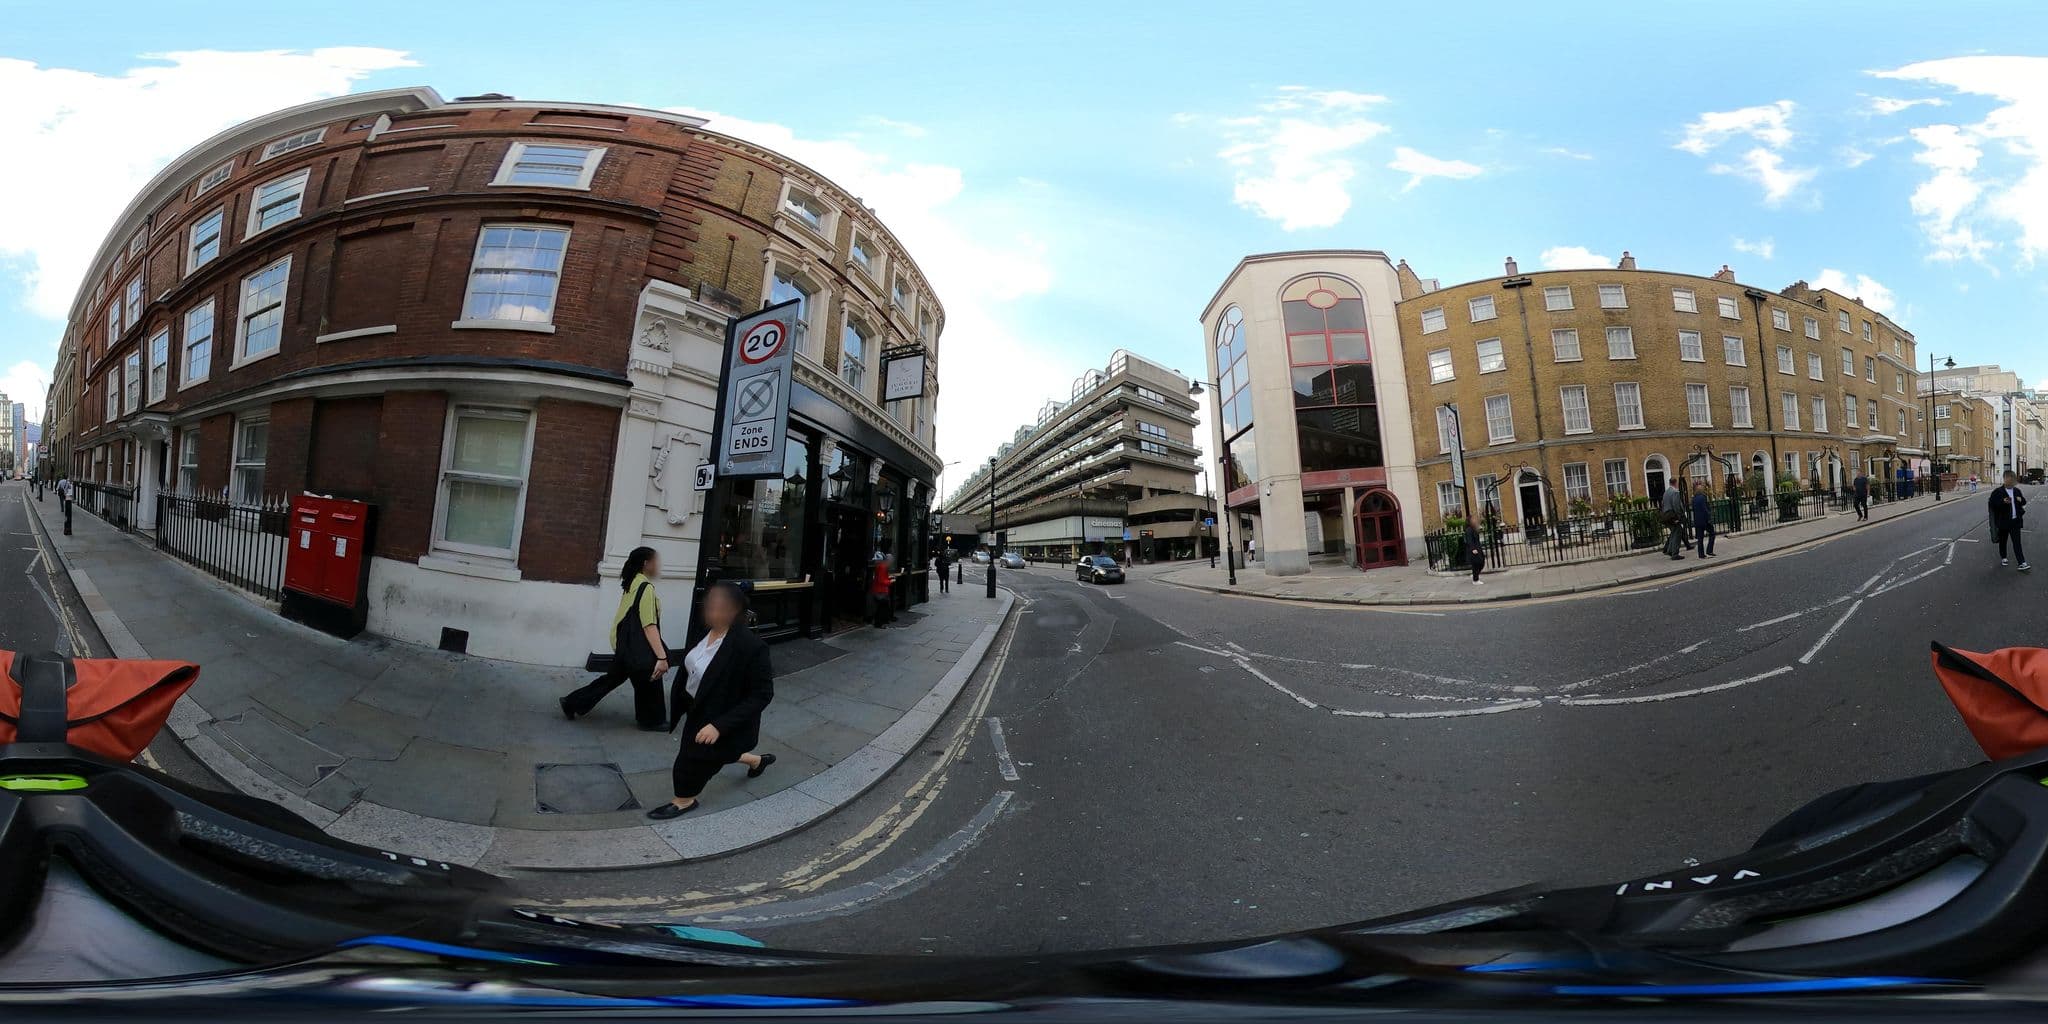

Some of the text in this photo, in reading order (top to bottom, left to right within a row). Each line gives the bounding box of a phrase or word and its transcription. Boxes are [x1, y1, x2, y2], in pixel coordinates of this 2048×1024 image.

[747, 330, 778, 353] 20
[741, 426, 763, 436] Zone
[734, 435, 768, 450] ENDS
[1091, 519, 1122, 527] cinemas
